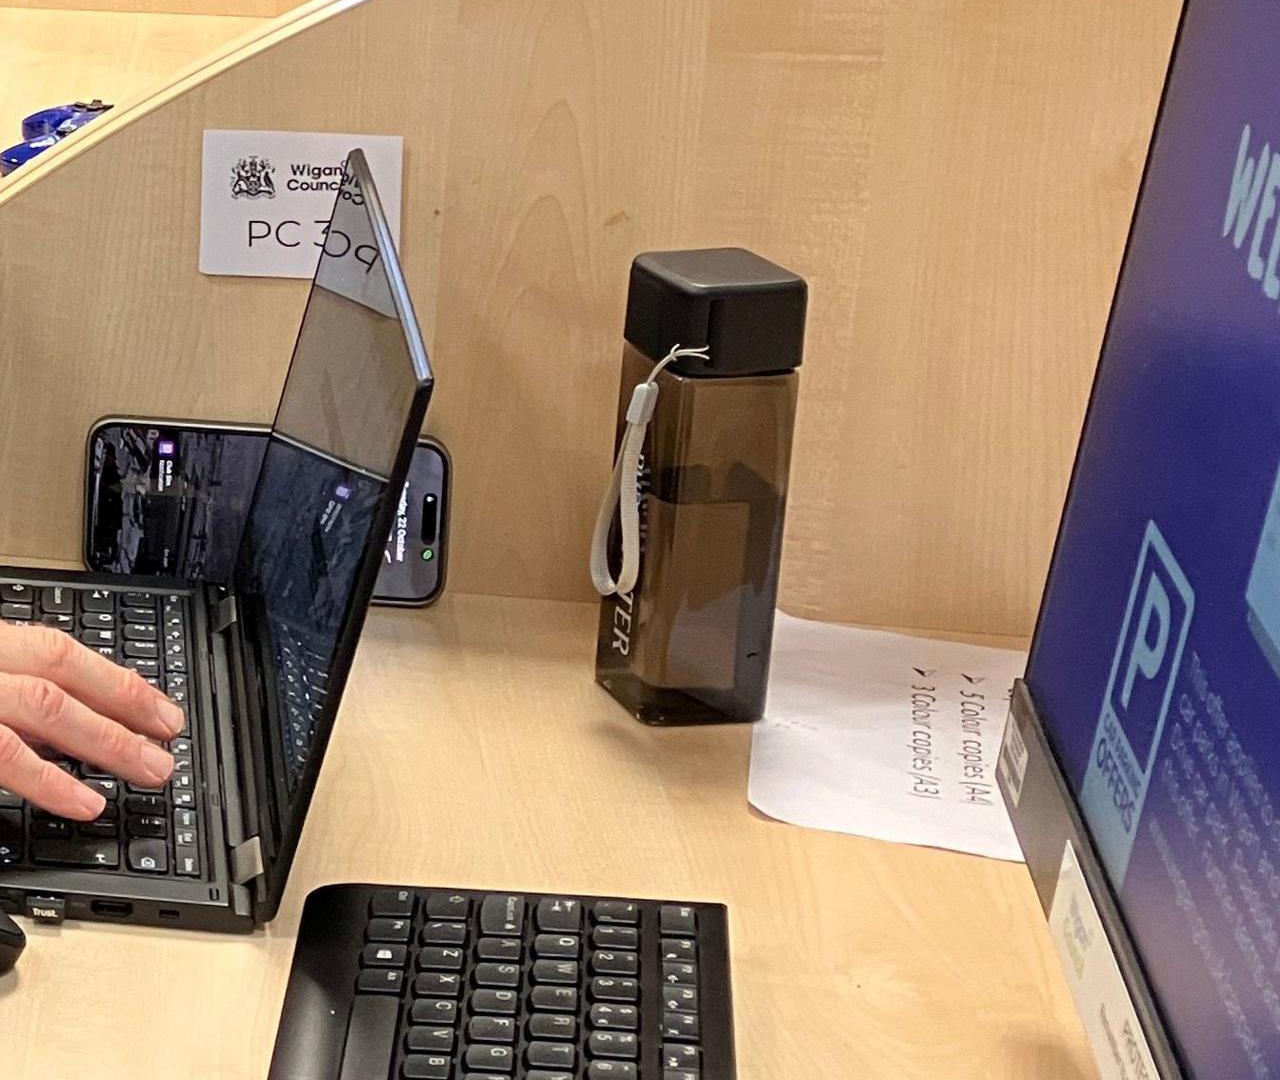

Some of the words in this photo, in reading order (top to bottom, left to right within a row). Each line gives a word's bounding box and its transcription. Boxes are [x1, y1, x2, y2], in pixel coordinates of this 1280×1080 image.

[286, 179, 341, 192] Counc
[290, 163, 343, 179] Wigan
[1222, 122, 1280, 301] WEL
[247, 220, 302, 248] PC
[611, 591, 635, 657] TER
[1122, 571, 1171, 711] P
[911, 693, 939, 729] Colour
[960, 700, 988, 737] Colour
[906, 730, 939, 772] copies
[957, 739, 990, 780] copies
[906, 771, 943, 800] (A3)
